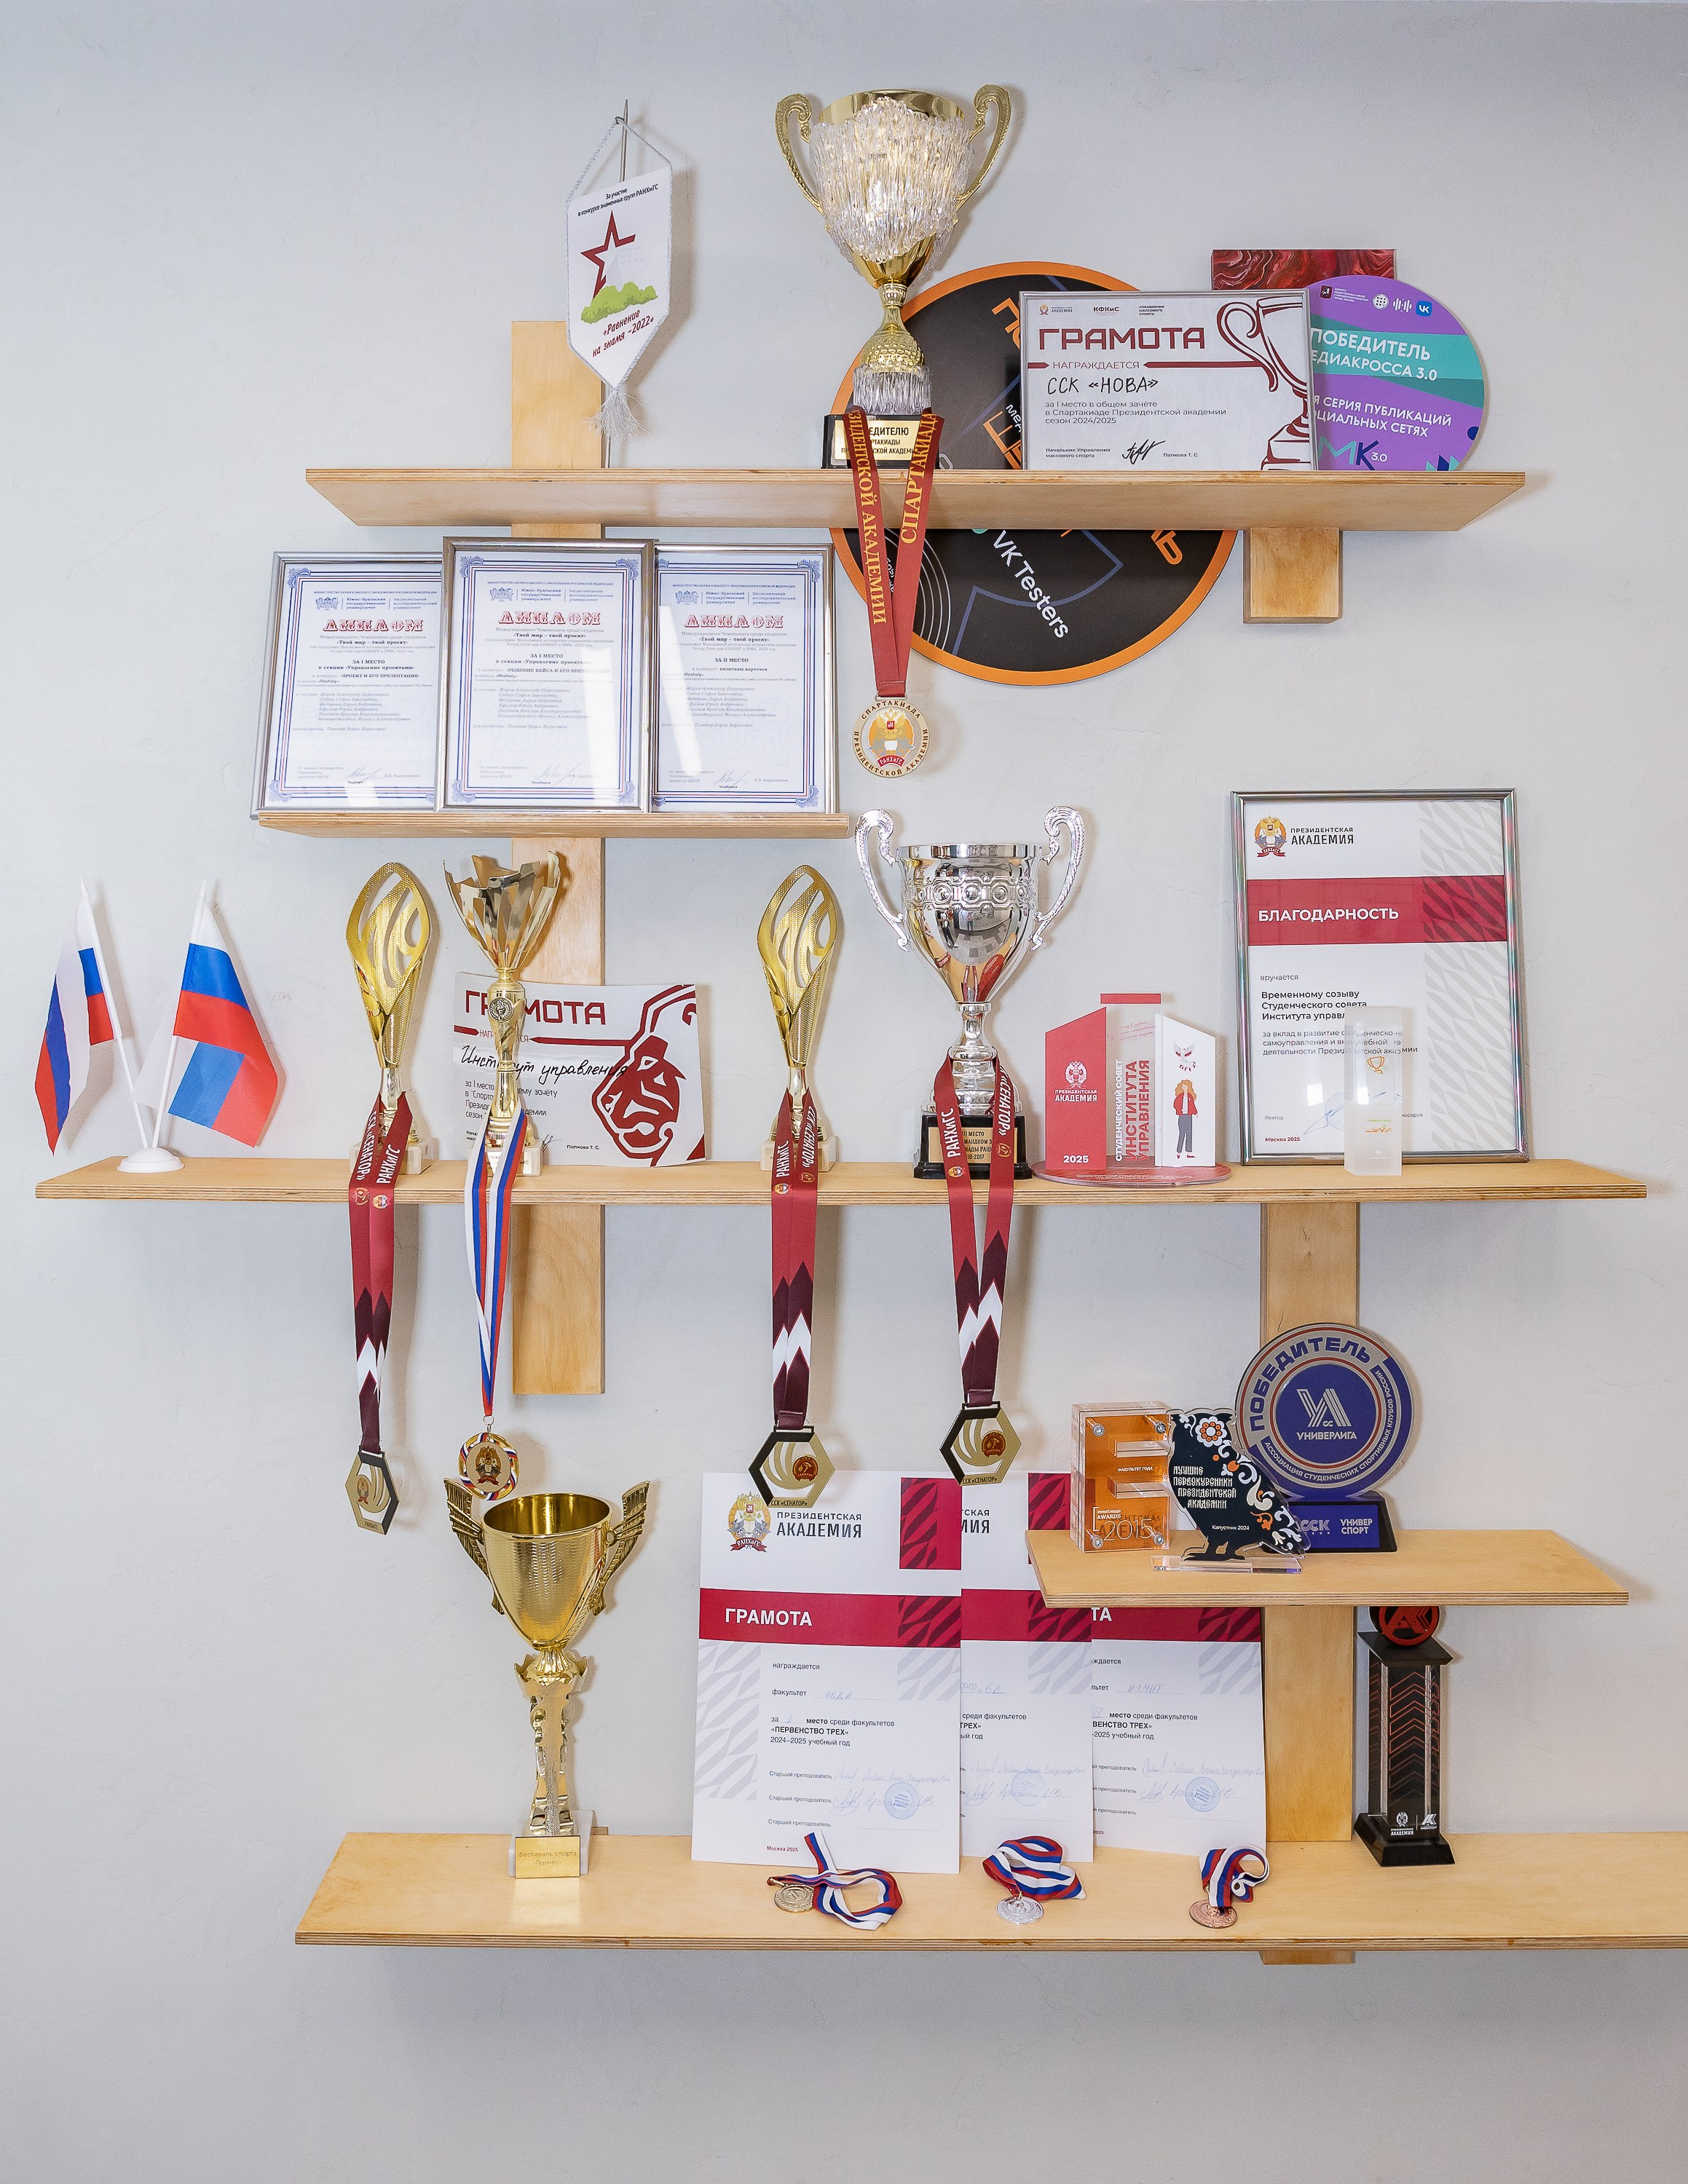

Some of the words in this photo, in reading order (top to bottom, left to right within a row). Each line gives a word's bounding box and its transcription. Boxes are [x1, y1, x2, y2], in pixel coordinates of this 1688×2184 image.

[581, 204, 600, 215] конкурсе
[600, 197, 623, 210] знаменных
[623, 191, 636, 205] групп
[636, 183, 658, 197] РАНХиГС
[606, 192, 614, 200] За
[613, 186, 628, 199] участие
[604, 309, 640, 336] «Равнение
[593, 345, 601, 357] на
[604, 332, 625, 351] знамя
[1038, 328, 1205, 350] ГРАМОТА
[1311, 328, 1431, 361] ПОБЕДИТЕЛЬ
[1052, 361, 1140, 370] НАГРАЖДАЕТСЯ
[1312, 349, 1413, 377] ЕДИАКРОССА
[1416, 367, 1437, 381] 3.0
[1047, 377, 1079, 395] ССК
[1089, 376, 1159, 394] «НОВА»
[1052, 409, 1111, 417] Спартакиаде
[1112, 408, 1180, 416] Президентской
[1323, 397, 1361, 411] СЕРИЯ
[1364, 403, 1452, 427] ПУБЛИКАЦИЙ
[1390, 423, 1429, 438] СЕТЯХ
[1370, 452, 1388, 462] 3.0
[901, 413, 936, 544] СПАРТАКИАДА
[862, 511, 886, 624] АКАДЕМИИ
[993, 530, 1023, 566] VK
[1013, 560, 1069, 639] Testers
[861, 700, 920, 719] СПАРТАКИАДА
[854, 731, 902, 776] ПРЕЗИДЕНТСКОЙ
[906, 729, 928, 772] АКАДЕМИИ
[879, 757, 903, 765] РАНХиГС
[1291, 834, 1354, 845] АКАДЕМИЯ
[1258, 907, 1399, 923] БЛАГОДАРНОСТЬ
[1261, 991, 1323, 1000] Временному
[1325, 990, 1360, 1000] созыву
[1261, 1001, 1333, 1010] Студенческого
[1262, 1011, 1312, 1021] Института
[1304, 1030, 1340, 1038] развитие
[538, 1060, 628, 1085] управления
[476, 1083, 494, 1091] место
[535, 1088, 558, 1098] зачёту
[1055, 1094, 1097, 1102] АКАДЕМИЯ
[998, 1075, 1011, 1136] «СЕНАТОР»
[1126, 1061, 1137, 1160] ИНСТИТУТА
[1138, 1060, 1150, 1160] УПРАВЛЕНИЯ
[465, 1111, 483, 1120] сезон
[941, 1107, 961, 1158] РАНХиГС
[1114, 1091, 1123, 1162] СТУДЕНЧЕСКИЙ
[802, 1123, 816, 1168] «СЕНАТОР»
[356, 1131, 375, 1181] «СЕНАТОР»
[776, 1140, 790, 1178] РАНХиГС
[1063, 1155, 1089, 1163] 2025
[376, 1144, 401, 1184] РАНХиГС
[1249, 1337, 1371, 1432] ПОБЕДИТЕЛЬ
[1264, 1441, 1304, 1478] АССОЦИАЦИЯ
[1304, 1466, 1360, 1482] СТУДЕНЧЕСКИХ
[1359, 1428, 1391, 1473] СПОРТИВНЫХ
[1375, 1370, 1393, 1397] РОССИИ
[1297, 1431, 1357, 1441] УНИВЕРЛИГА
[1173, 1466, 1203, 1476] ЛУЧШИЕ
[972, 1476, 998, 1484] «СЕНАТОР»
[1173, 1477, 1233, 1487] ПЕРВОКУРСНИКИ
[1178, 1488, 1237, 1498] ПРЕЗИДЕНТСКОЙ
[1188, 1500, 1227, 1508] АКАДЕМИИ
[777, 1511, 862, 1521] ПРЕЗИДЕНТСКАЯ
[776, 1522, 862, 1538] АКАДЕМИЯ
[1103, 1519, 1152, 1541] 2015
[736, 1538, 762, 1547] РАНХиГС
[725, 1607, 813, 1626] ГРАМОТА
[773, 1662, 820, 1671] награждается
[772, 1688, 807, 1697] факультет
[830, 1719, 850, 1727] среди
[851, 1719, 895, 1728] факультетов
[984, 1713, 1027, 1721] факультетов
[1154, 1713, 1198, 1721] факультетов
[771, 1726, 824, 1735] «ПЕРВЕНСТВО
[808, 1738, 837, 1746] учебный
